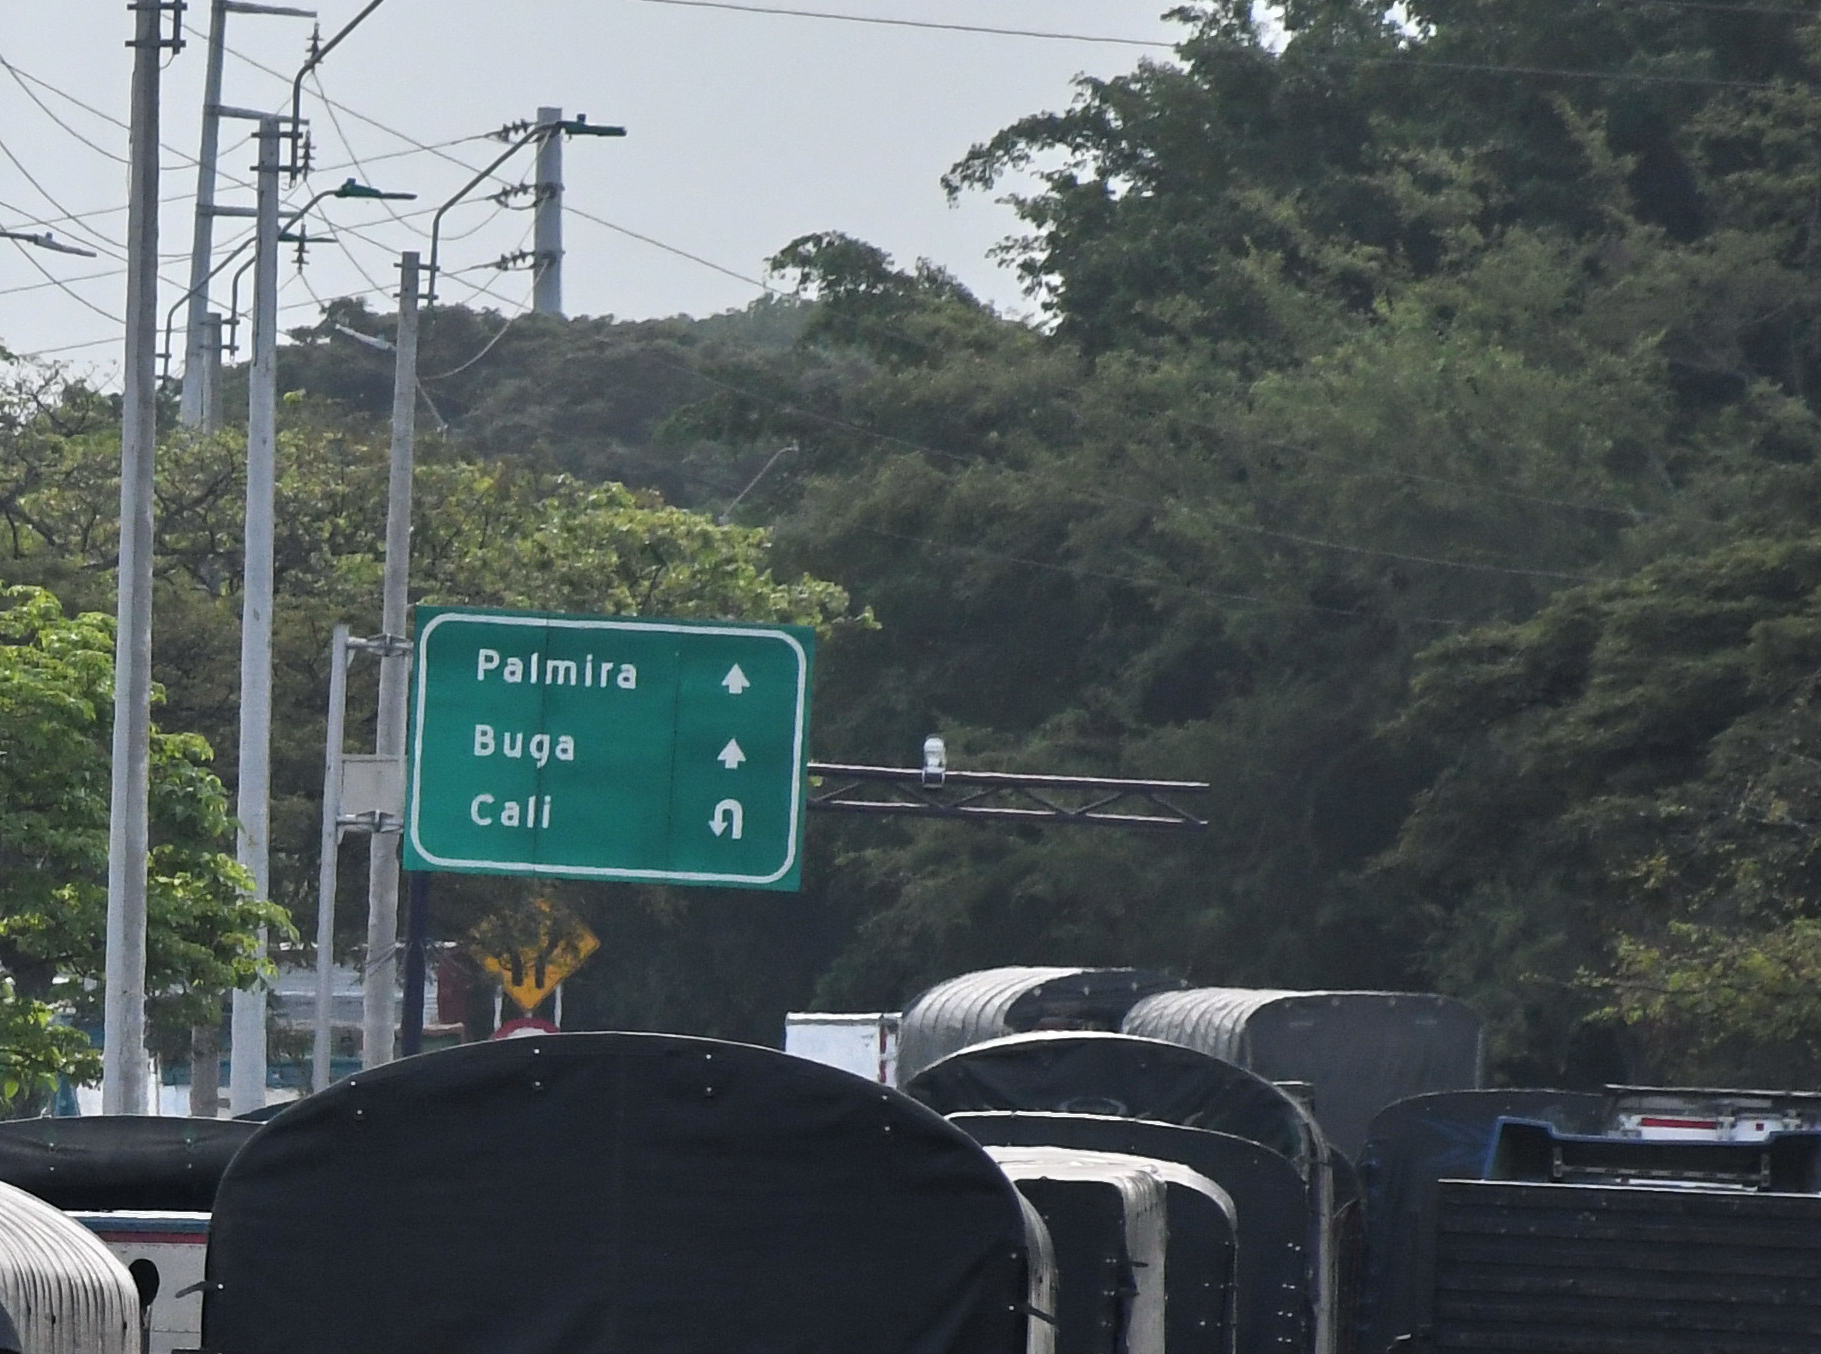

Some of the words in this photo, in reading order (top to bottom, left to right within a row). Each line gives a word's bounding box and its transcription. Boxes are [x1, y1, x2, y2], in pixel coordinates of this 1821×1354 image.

[477, 648, 637, 690] Palmira
[473, 724, 575, 769] Buga
[470, 793, 551, 829] Cali
